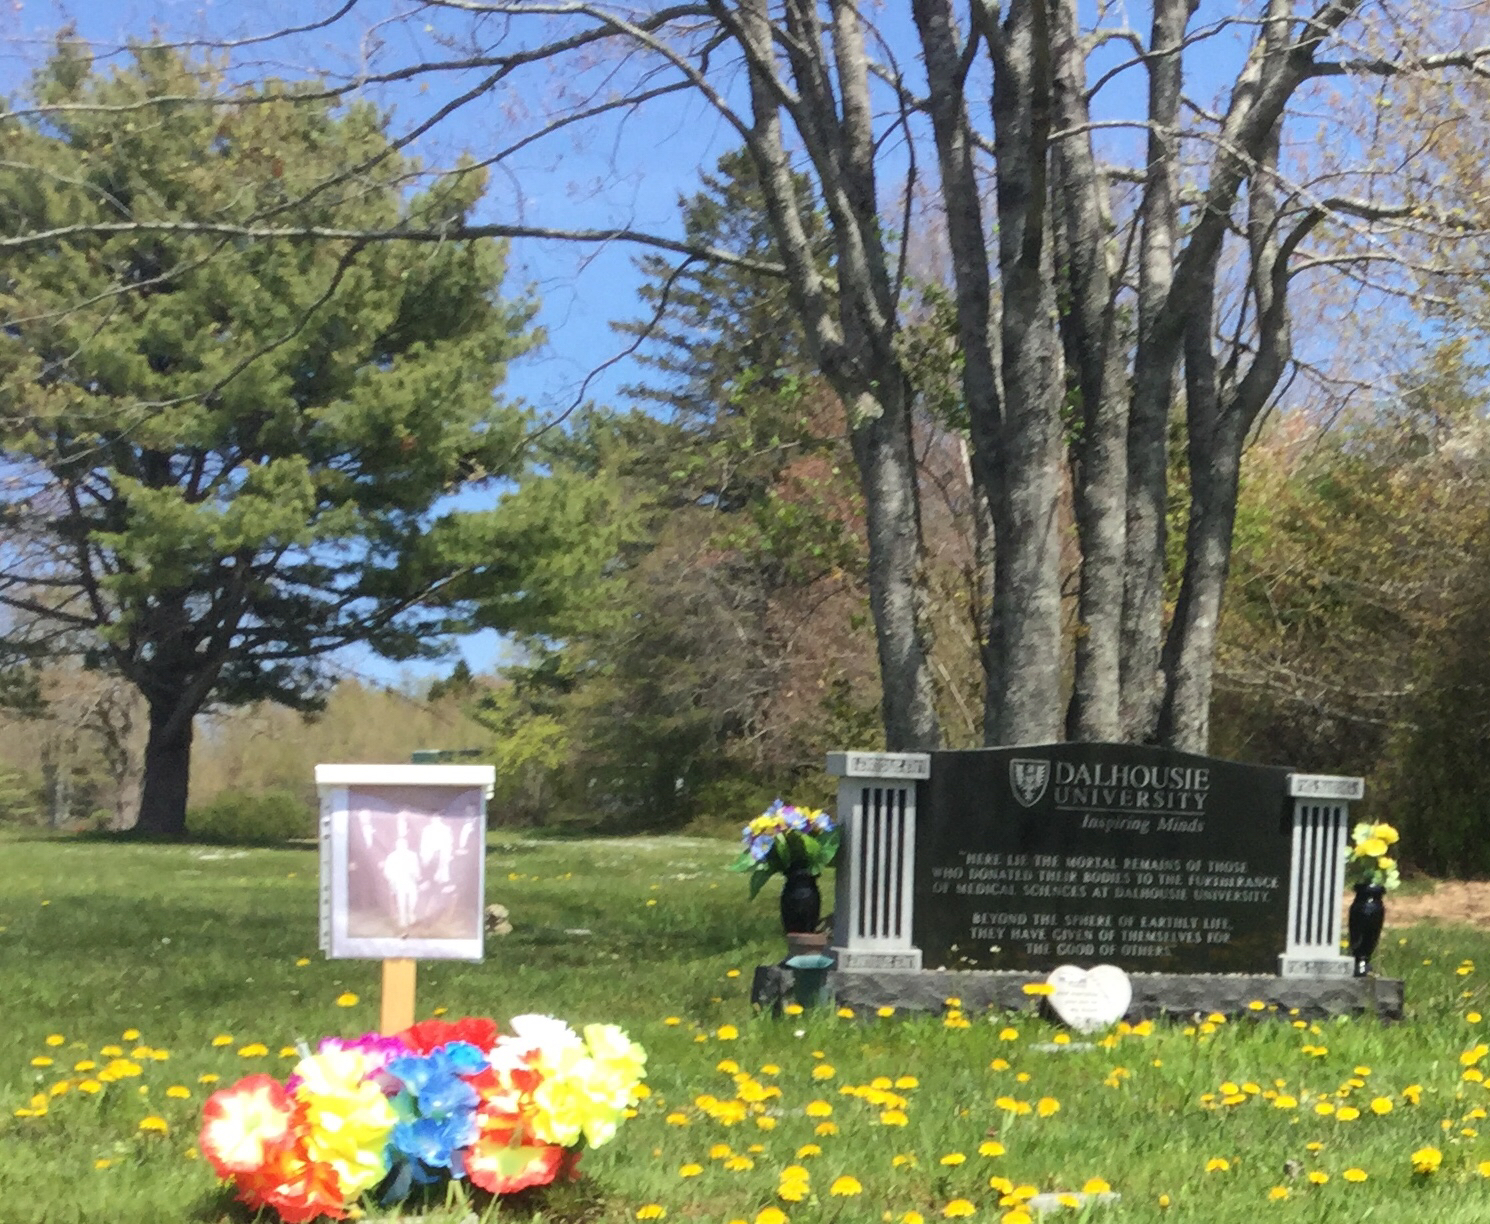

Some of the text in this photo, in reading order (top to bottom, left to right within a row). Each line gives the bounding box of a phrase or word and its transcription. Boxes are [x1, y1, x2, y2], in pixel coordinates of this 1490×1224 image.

[1055, 761, 1211, 790] DALHOUSIE
[1054, 787, 1209, 810] UNIVERSITY
[1081, 814, 1205, 834] Inspiring Minds
[1006, 854, 1028, 866] LIE
[1034, 854, 1060, 867] THE
[1066, 856, 1118, 869] MORTAL
[1123, 857, 1182, 871] REMAINS
[1185, 859, 1202, 872] OF
[1208, 860, 1248, 873] THOSE
[931, 867, 1279, 889] WHO DONATED THEIR BODIES TO THE FURTHERANCE
[932, 882, 949, 894] OF
[955, 882, 1016, 895] MEDICAL
[1091, 886, 1110, 898] AT
[1114, 886, 1188, 900] DALHOUSIE
[972, 912, 1028, 925] BEYOND
[1033, 913, 1058, 926] THE
[1064, 914, 1112, 927] SPHERE
[1118, 915, 1134, 927] OF
[1140, 916, 1199, 929] EARTHLY
[970, 926, 1231, 944] THEY HAVE GIVEN OF THEMSELVES FOR
[1026, 942, 1050, 955] THE
[1056, 943, 1095, 956] GOOD
[1099, 944, 1116, 956] OF
